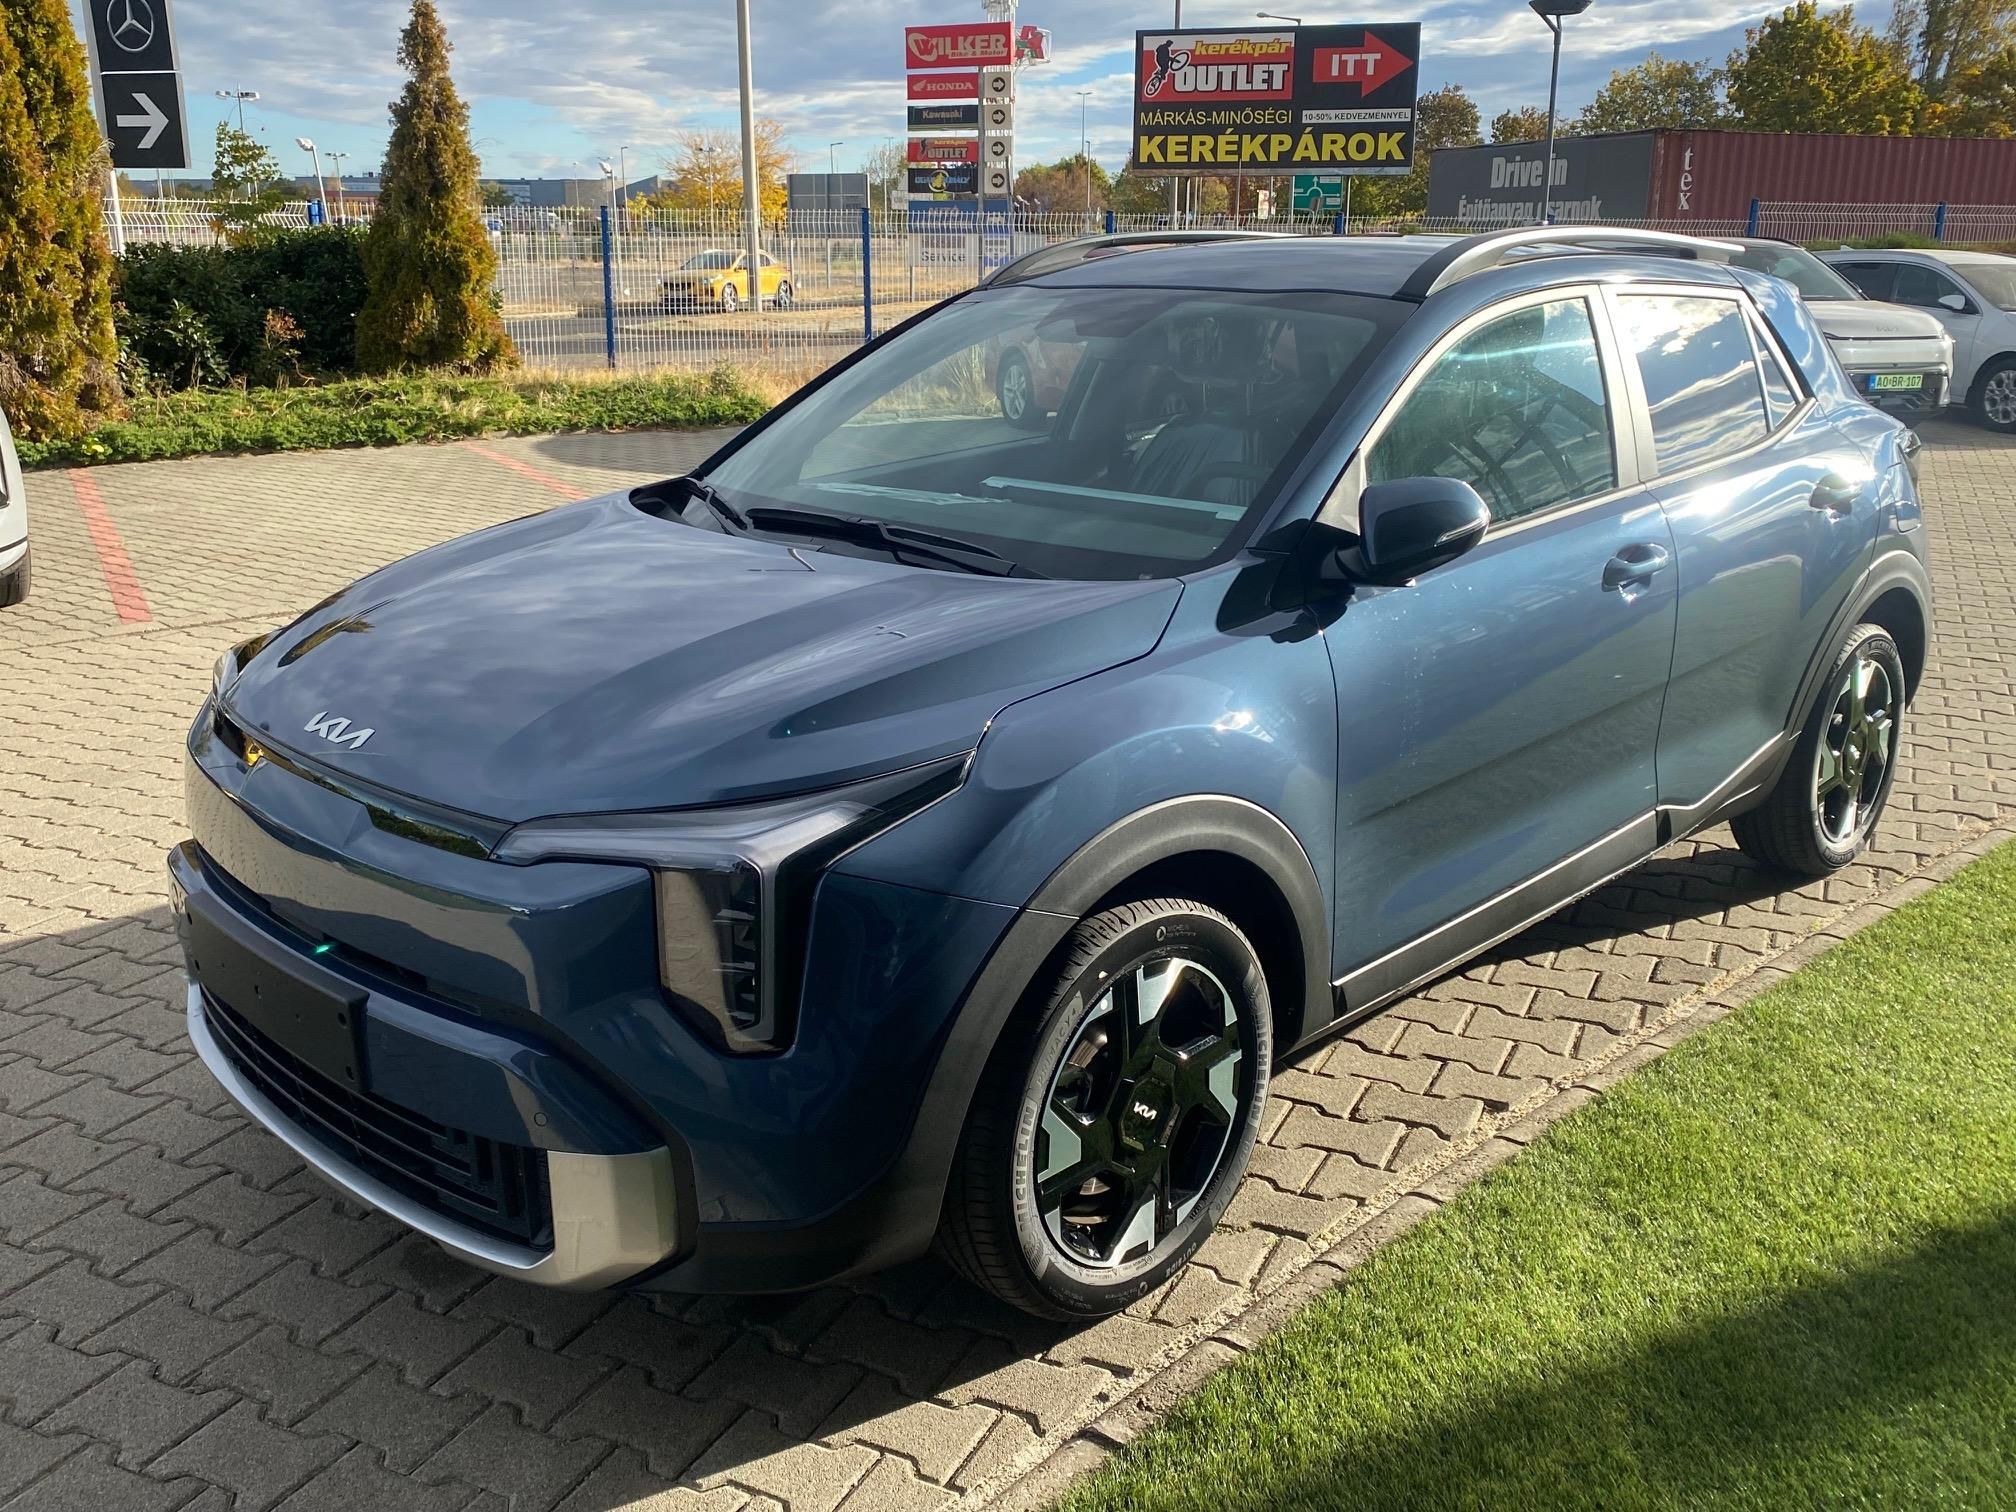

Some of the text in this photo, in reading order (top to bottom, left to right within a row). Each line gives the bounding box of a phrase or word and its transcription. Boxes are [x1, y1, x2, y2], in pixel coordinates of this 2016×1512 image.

[908, 32, 1007, 61] WILKER
[1194, 38, 1291, 57] kerékpár
[1174, 62, 1289, 92] OUTLET
[1331, 53, 1382, 76] ITT
[926, 82, 974, 91] HONDA
[1140, 107, 1292, 126] MÁRKÁS-MINŐSÉGI
[1304, 110, 1410, 121] 10-50% KEDVEZMÉNNYEL
[928, 147, 968, 158] OUTLET
[1139, 127, 1406, 163] KERÉKPÁROK
[1490, 153, 1568, 189] Drive in
[1678, 147, 1694, 211] tex
[303, 711, 376, 750] KIA
[1250, 1012, 1268, 1124] MICHELIN
[1015, 1104, 1037, 1232] MICHELIN
